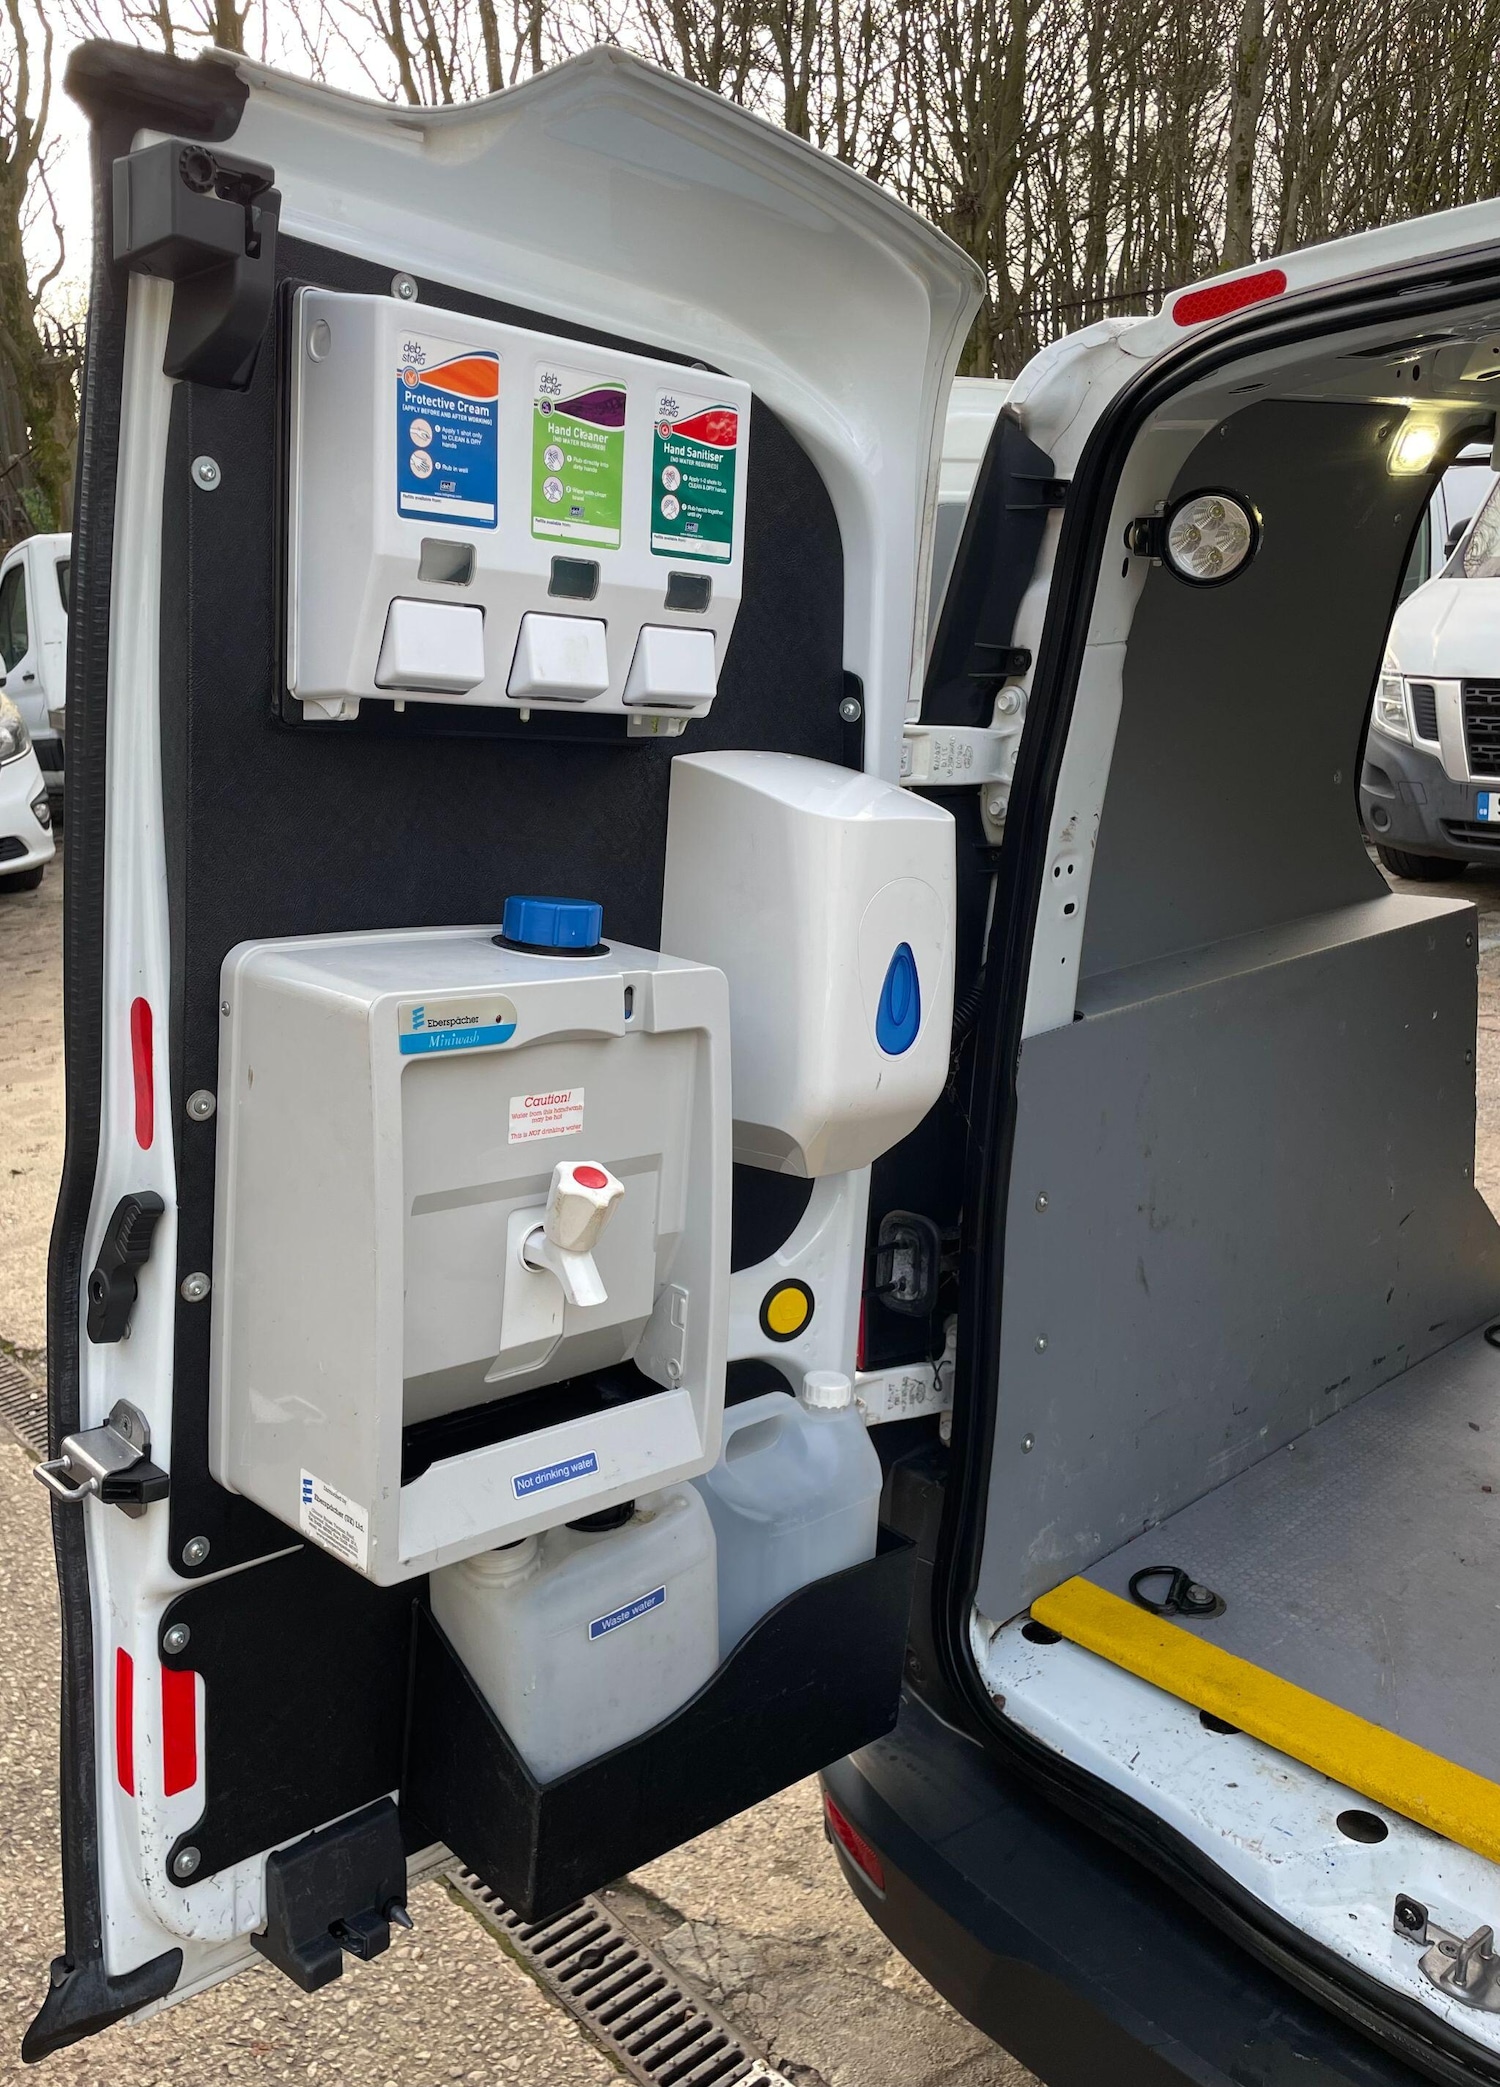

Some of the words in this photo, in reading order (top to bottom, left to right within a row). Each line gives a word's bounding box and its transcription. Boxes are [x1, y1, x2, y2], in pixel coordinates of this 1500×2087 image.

[403, 340, 421, 354] deb
[402, 352, 426, 365] stoko
[541, 372, 558, 386] deb
[539, 384, 562, 396] stoko
[404, 390, 455, 411] Protective
[457, 400, 490, 417] Cream
[660, 395, 675, 408] deb
[420, 407, 441, 417] BEFORE
[440, 411, 452, 419] AND
[451, 413, 467, 422] AFTER
[659, 406, 680, 418] stoko
[441, 426, 456, 435] Apply
[547, 422, 572, 438] Hand
[573, 427, 609, 444] Cleaner
[447, 434, 465, 443] CLEAN
[562, 438, 580, 447] WATER
[664, 442, 686, 456] Hand
[686, 447, 724, 462] Sanitiser
[679, 458, 695, 466] WATER
[427, 1015, 479, 1028] Eberspächer
[428, 1030, 480, 1048] Miniwash
[524, 1091, 572, 1109] Caution!
[511, 1112, 529, 1120] Water
[528, 1109, 543, 1118] from
[542, 1108, 553, 1116] this
[553, 1104, 583, 1114] handwash
[510, 1132, 523, 1140] This
[528, 1129, 541, 1137] NOT
[541, 1126, 565, 1135] drinking
[516, 1477, 534, 1491] Not
[534, 1466, 570, 1485] drinking
[570, 1458, 594, 1473] water
[601, 1611, 631, 1630] Waste
[631, 1596, 656, 1615] water
